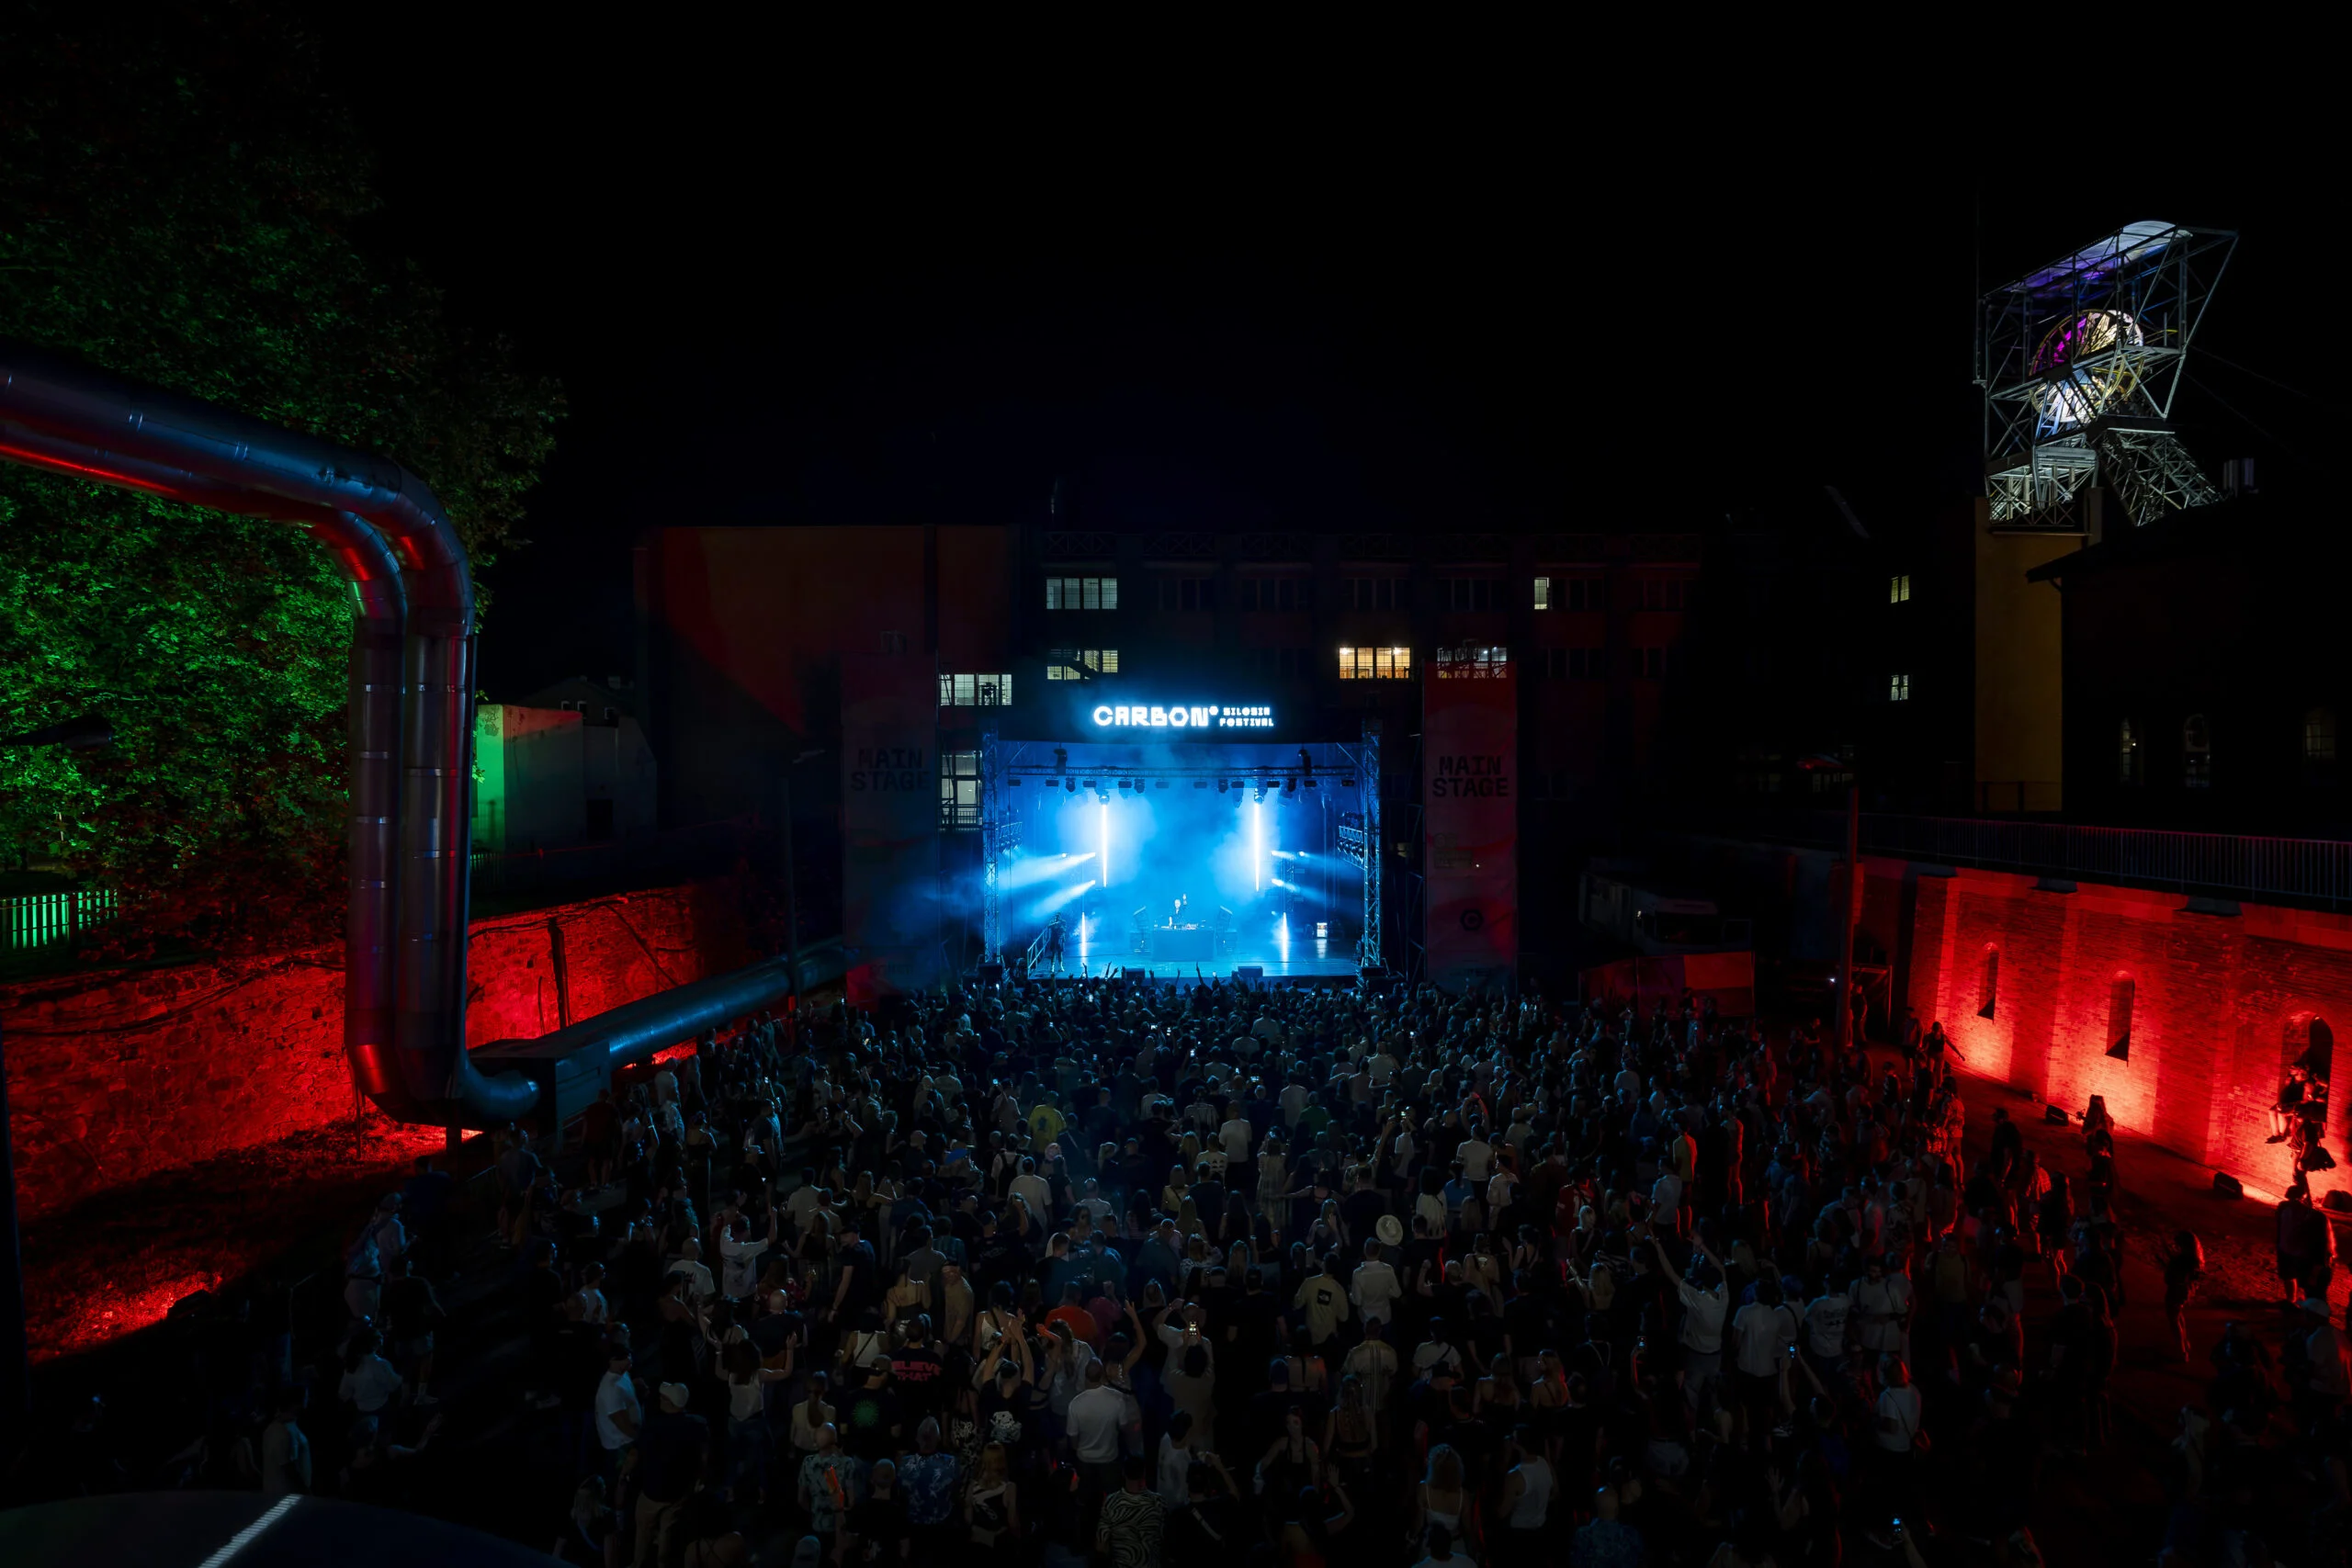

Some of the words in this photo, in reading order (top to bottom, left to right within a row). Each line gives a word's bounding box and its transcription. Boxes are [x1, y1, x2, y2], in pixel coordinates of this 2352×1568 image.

[858, 748, 922, 768] MAIN
[1439, 756, 1501, 775] MAIN
[851, 771, 931, 791] STAGE
[1433, 777, 1509, 797] STAGE
